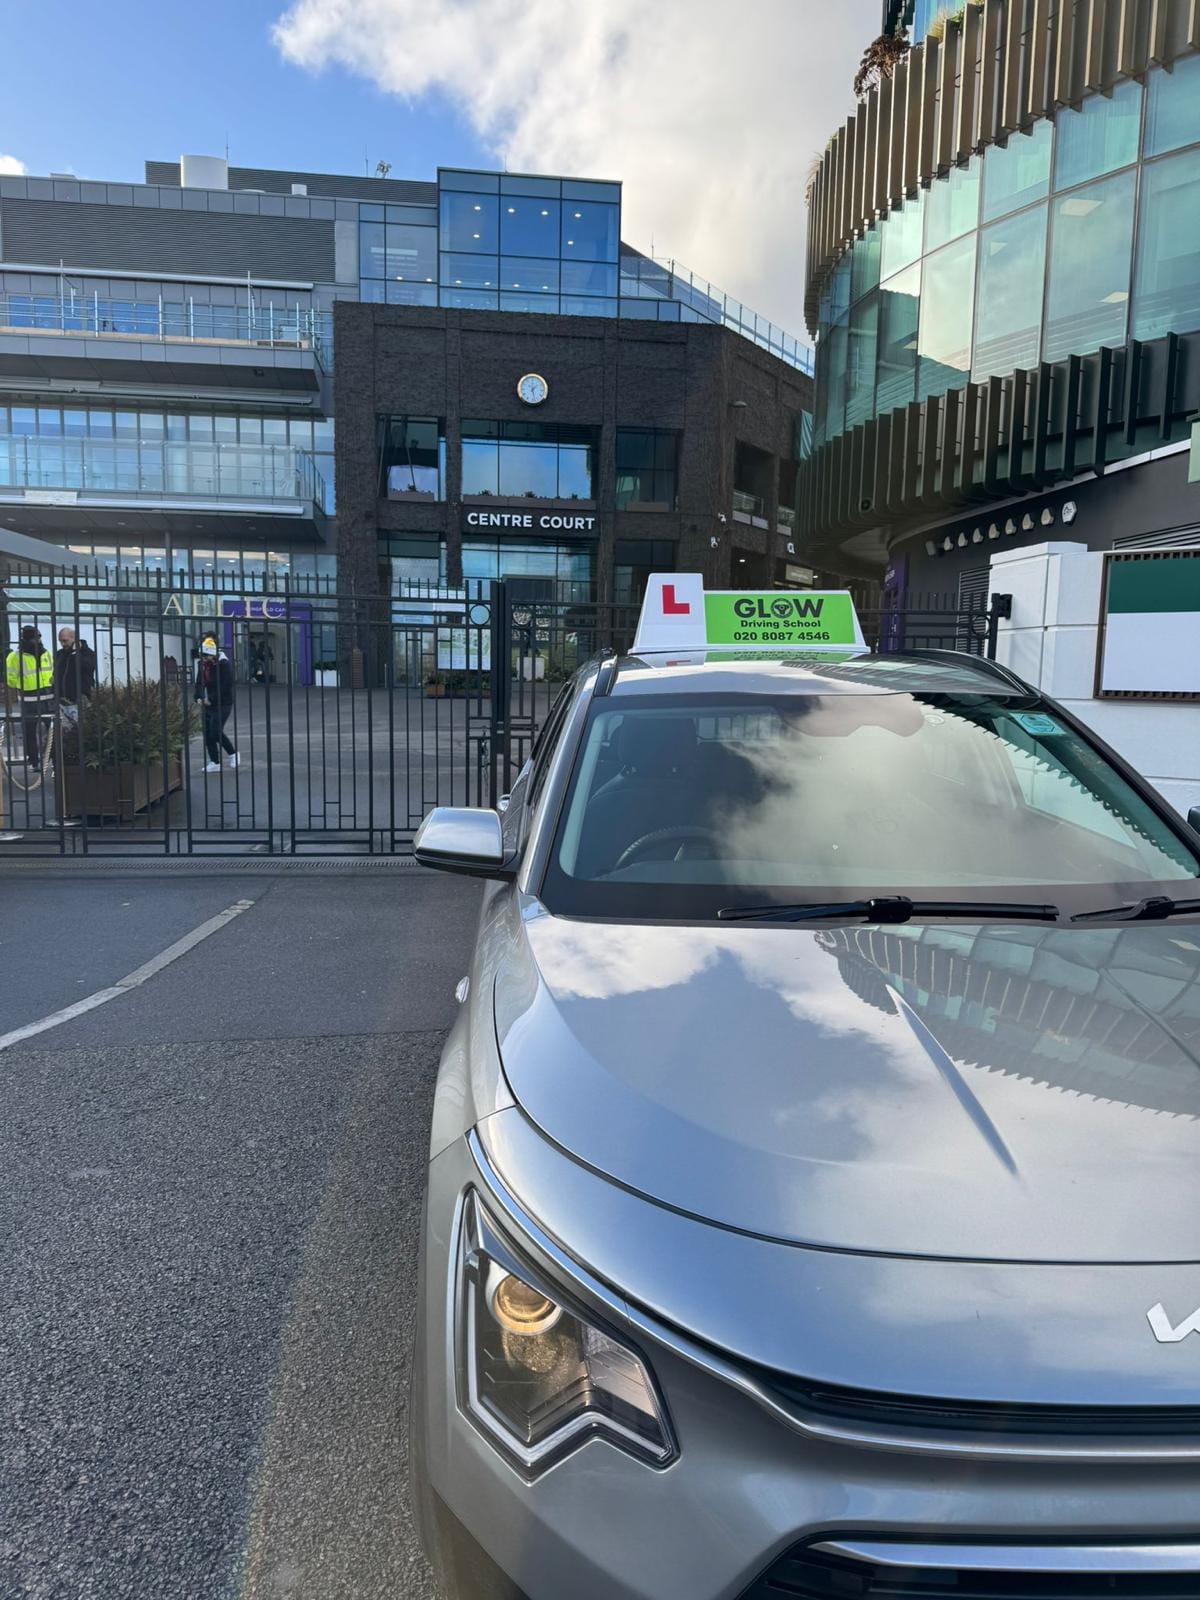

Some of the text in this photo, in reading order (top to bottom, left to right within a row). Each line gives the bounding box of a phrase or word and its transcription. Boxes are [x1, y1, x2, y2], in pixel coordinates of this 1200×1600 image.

[467, 512, 595, 530] CENTRE COURT
[662, 584, 690, 614] L
[734, 598, 824, 618] GLOW
[740, 620, 821, 629] Driving School
[733, 632, 830, 641] 020 8087 4546
